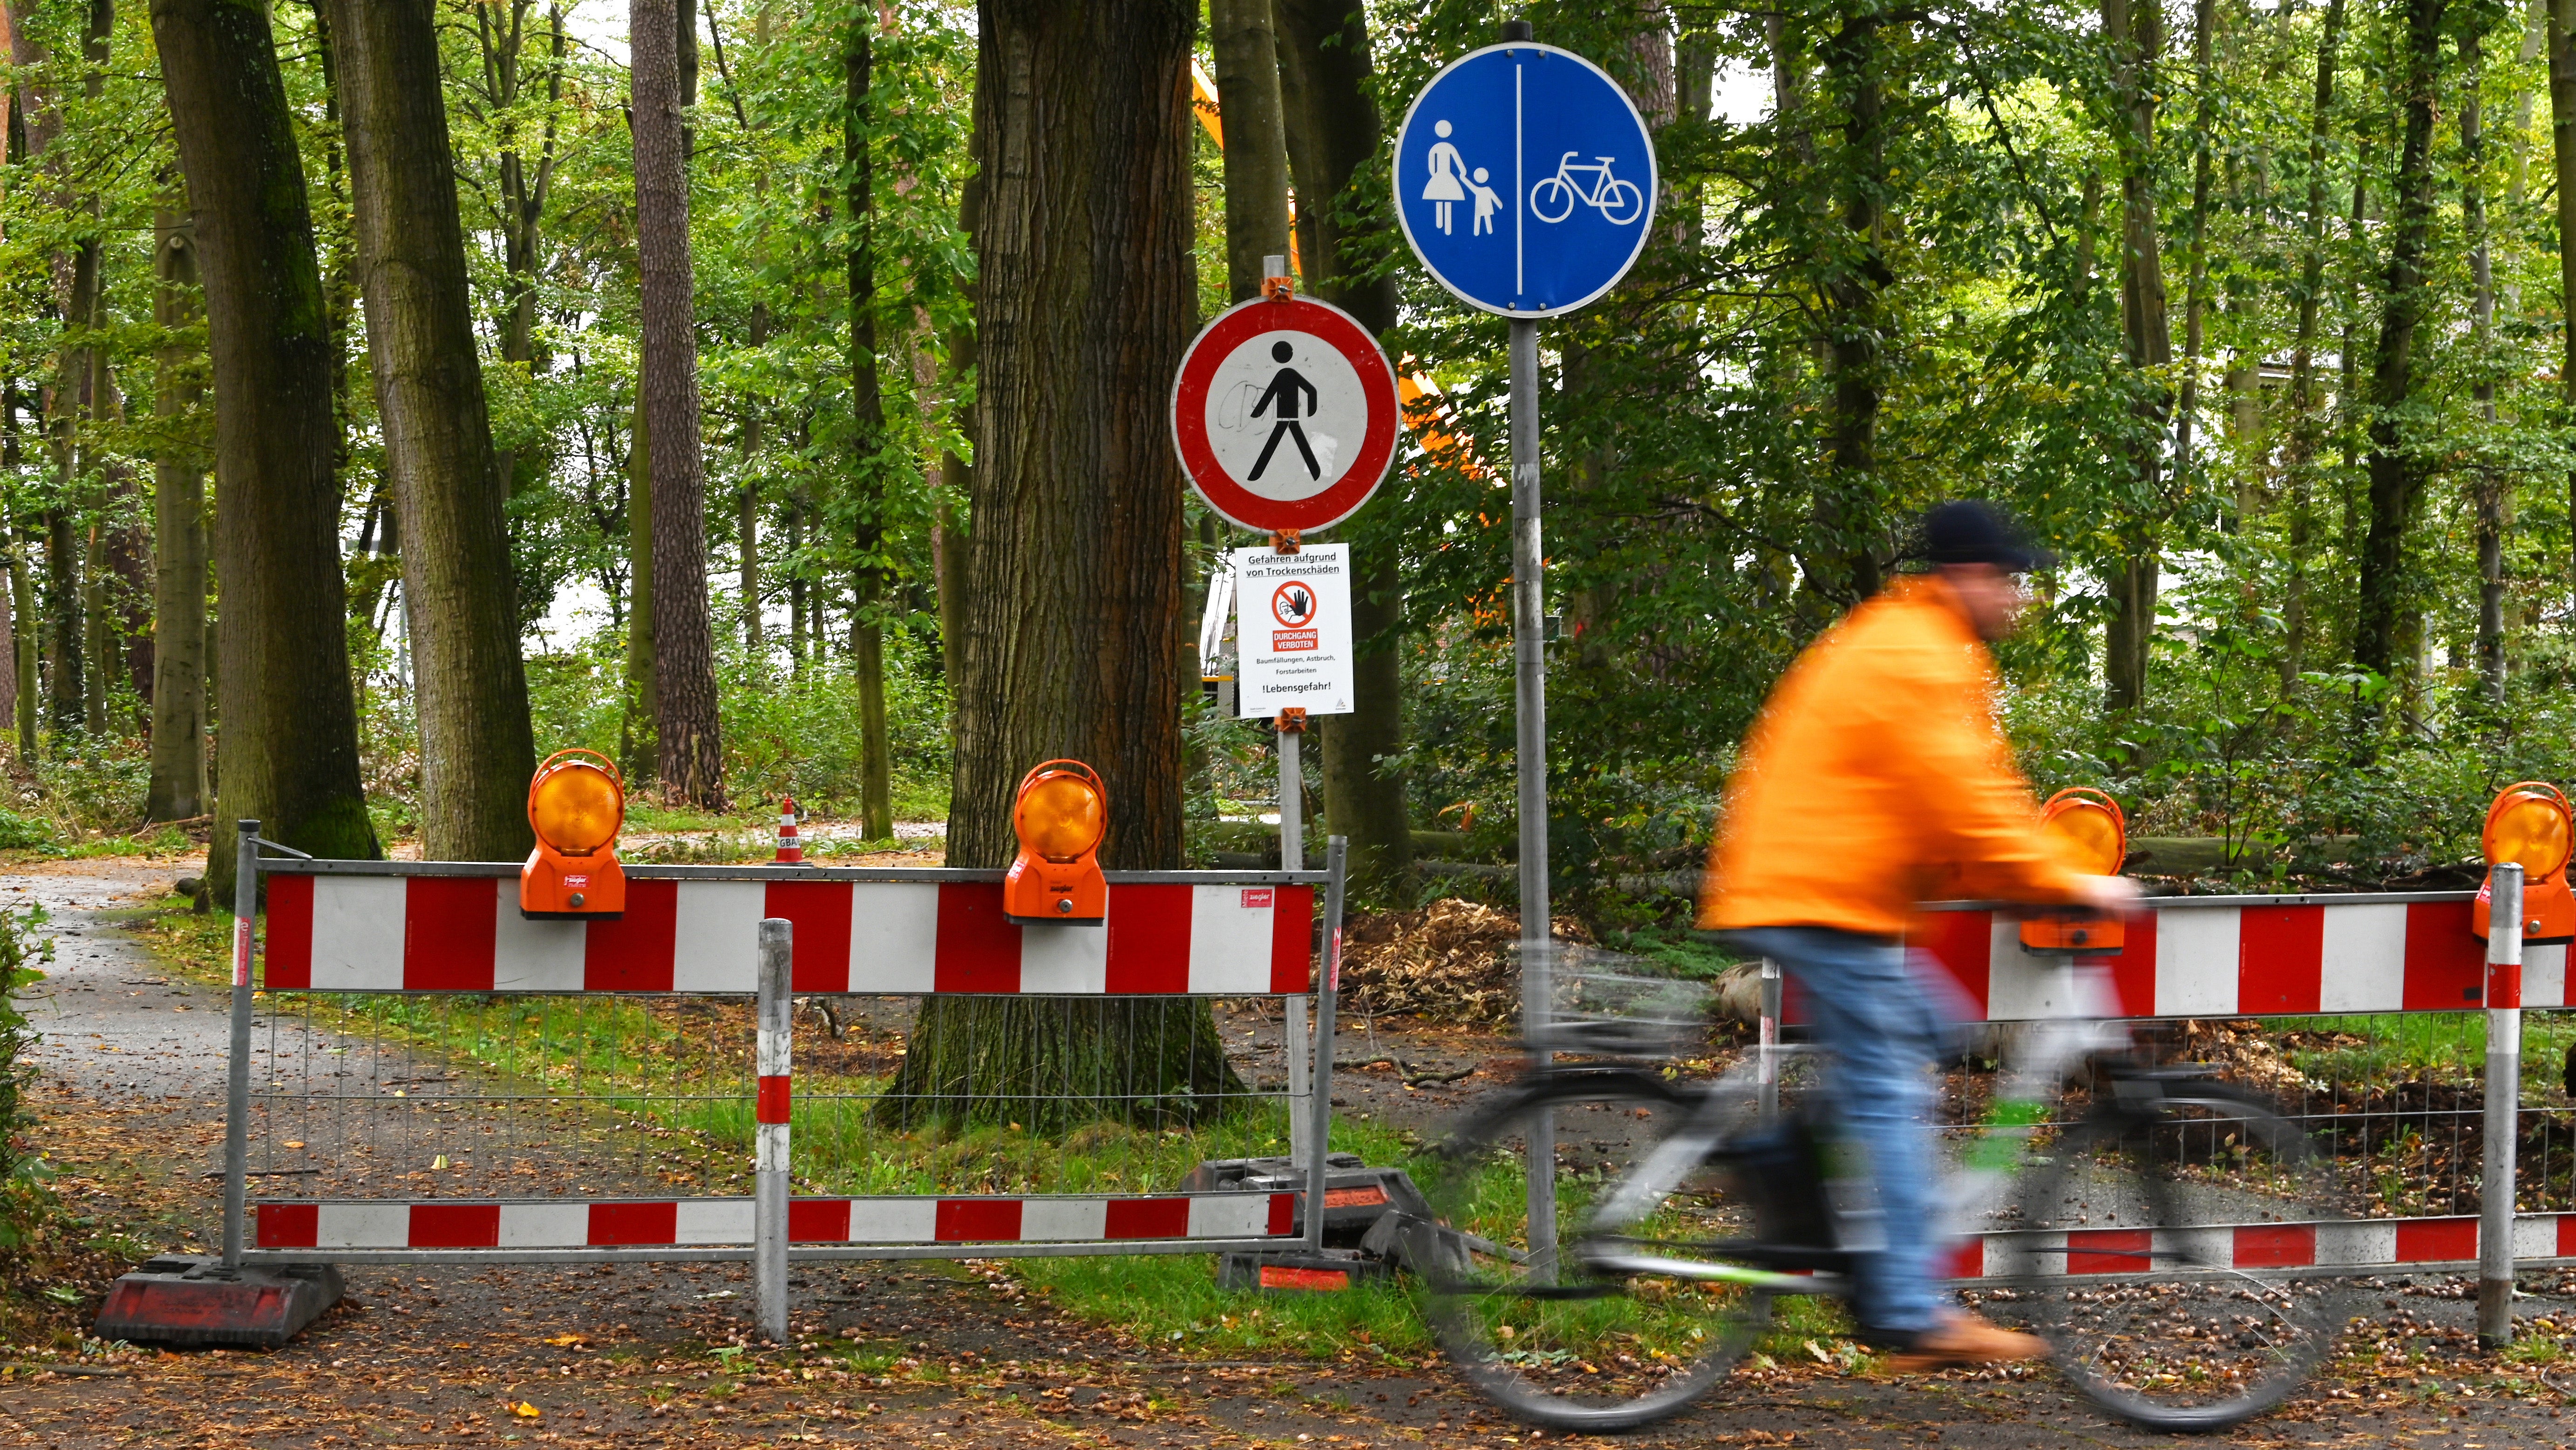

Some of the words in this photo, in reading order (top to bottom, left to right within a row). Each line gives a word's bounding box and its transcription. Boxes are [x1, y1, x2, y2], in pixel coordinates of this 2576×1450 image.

[1249, 555, 1291, 564] Gefahren
[1294, 552, 1336, 563] aufgrund
[1266, 565, 1339, 576] Trockenschäden
[1274, 631, 1317, 641] DURCHGANG
[1278, 640, 1313, 649] VERBOTEN
[1263, 682, 1331, 693] !Lebensgefahr!
[1050, 885, 1073, 893] ziegler
